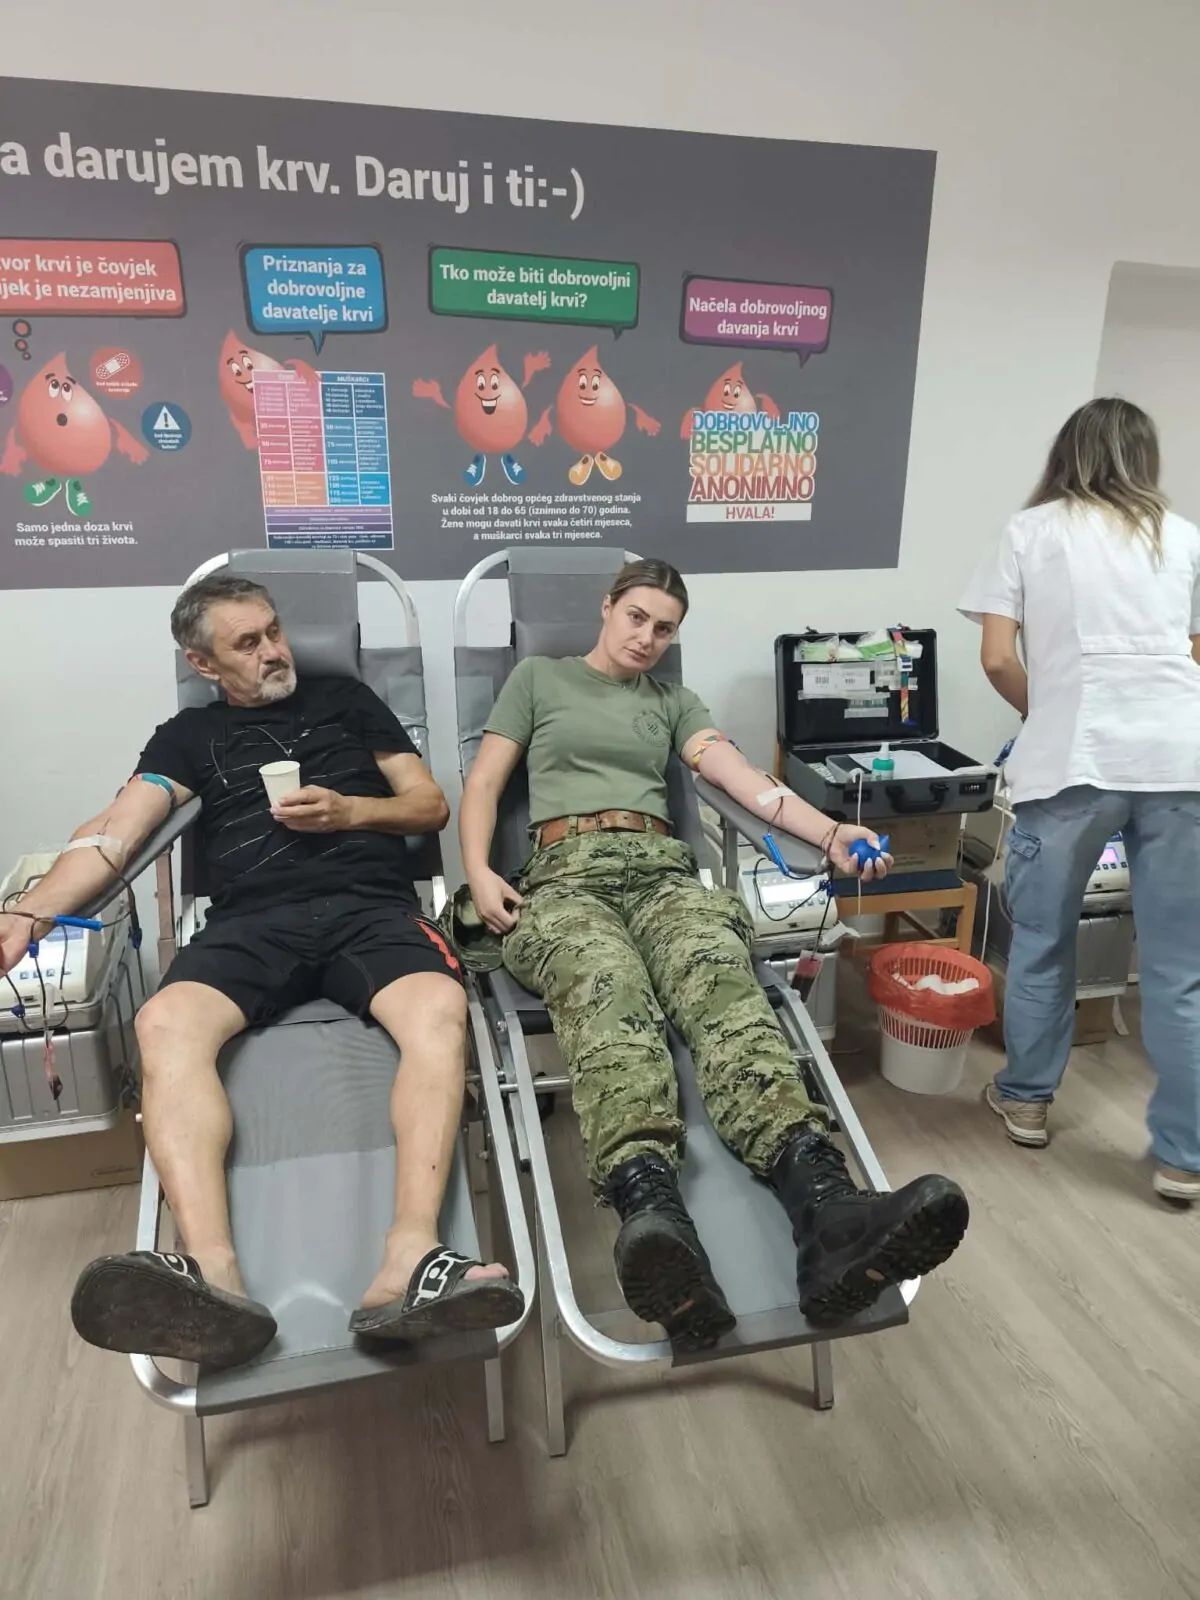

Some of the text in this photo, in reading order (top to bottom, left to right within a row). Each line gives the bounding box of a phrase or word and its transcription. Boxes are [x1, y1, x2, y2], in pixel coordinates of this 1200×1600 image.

[44, 132, 243, 195] darujem
[257, 145, 340, 195] krv.
[355, 155, 470, 213] Daruj
[483, 162, 493, 204] i
[506, 165, 584, 220] ti:-)
[0, 254, 156, 279] vor krvi je čovjek
[263, 255, 366, 277] Priznanja za
[440, 264, 630, 289] Tko može biti dobrovoljni
[35, 279, 52, 300] je
[57, 281, 176, 304] nezamjenjiva
[267, 279, 366, 301] dobrovoljne
[487, 289, 587, 309] davatelj krvi?
[262, 302, 373, 324] davatelje krvi
[689, 296, 828, 319] Načela dobrovoljnog
[717, 320, 799, 338] davanja krvi
[692, 412, 818, 431] DOBROVOLJNO
[691, 431, 816, 453] BESPLATNO
[690, 453, 815, 476] SOLIDARNO
[690, 475, 814, 499] ANONIMNO
[431, 494, 641, 504] Svaki čovjek dobrog općeg zdravstvenog stanja
[450, 506, 471, 515] dobi
[473, 506, 485, 515] od
[487, 507, 499, 515] 18
[501, 506, 512, 515] do
[514, 507, 526, 515] 65
[528, 506, 567, 516] (iznimno
[569, 506, 580, 515] do
[582, 506, 597, 516] 70)
[599, 506, 631, 515] godina.
[725, 506, 775, 519] HVALA!
[16, 521, 133, 534] Samo jedna doza krvi
[441, 518, 632, 530] Žene mogu davati krvi svaka četiri mjeseca,
[15, 533, 138, 548] može spasiti tri života.
[481, 530, 522, 540] muškarci
[525, 531, 550, 540] svaka
[552, 531, 563, 539] tri
[565, 531, 603, 541] mjeseca.
